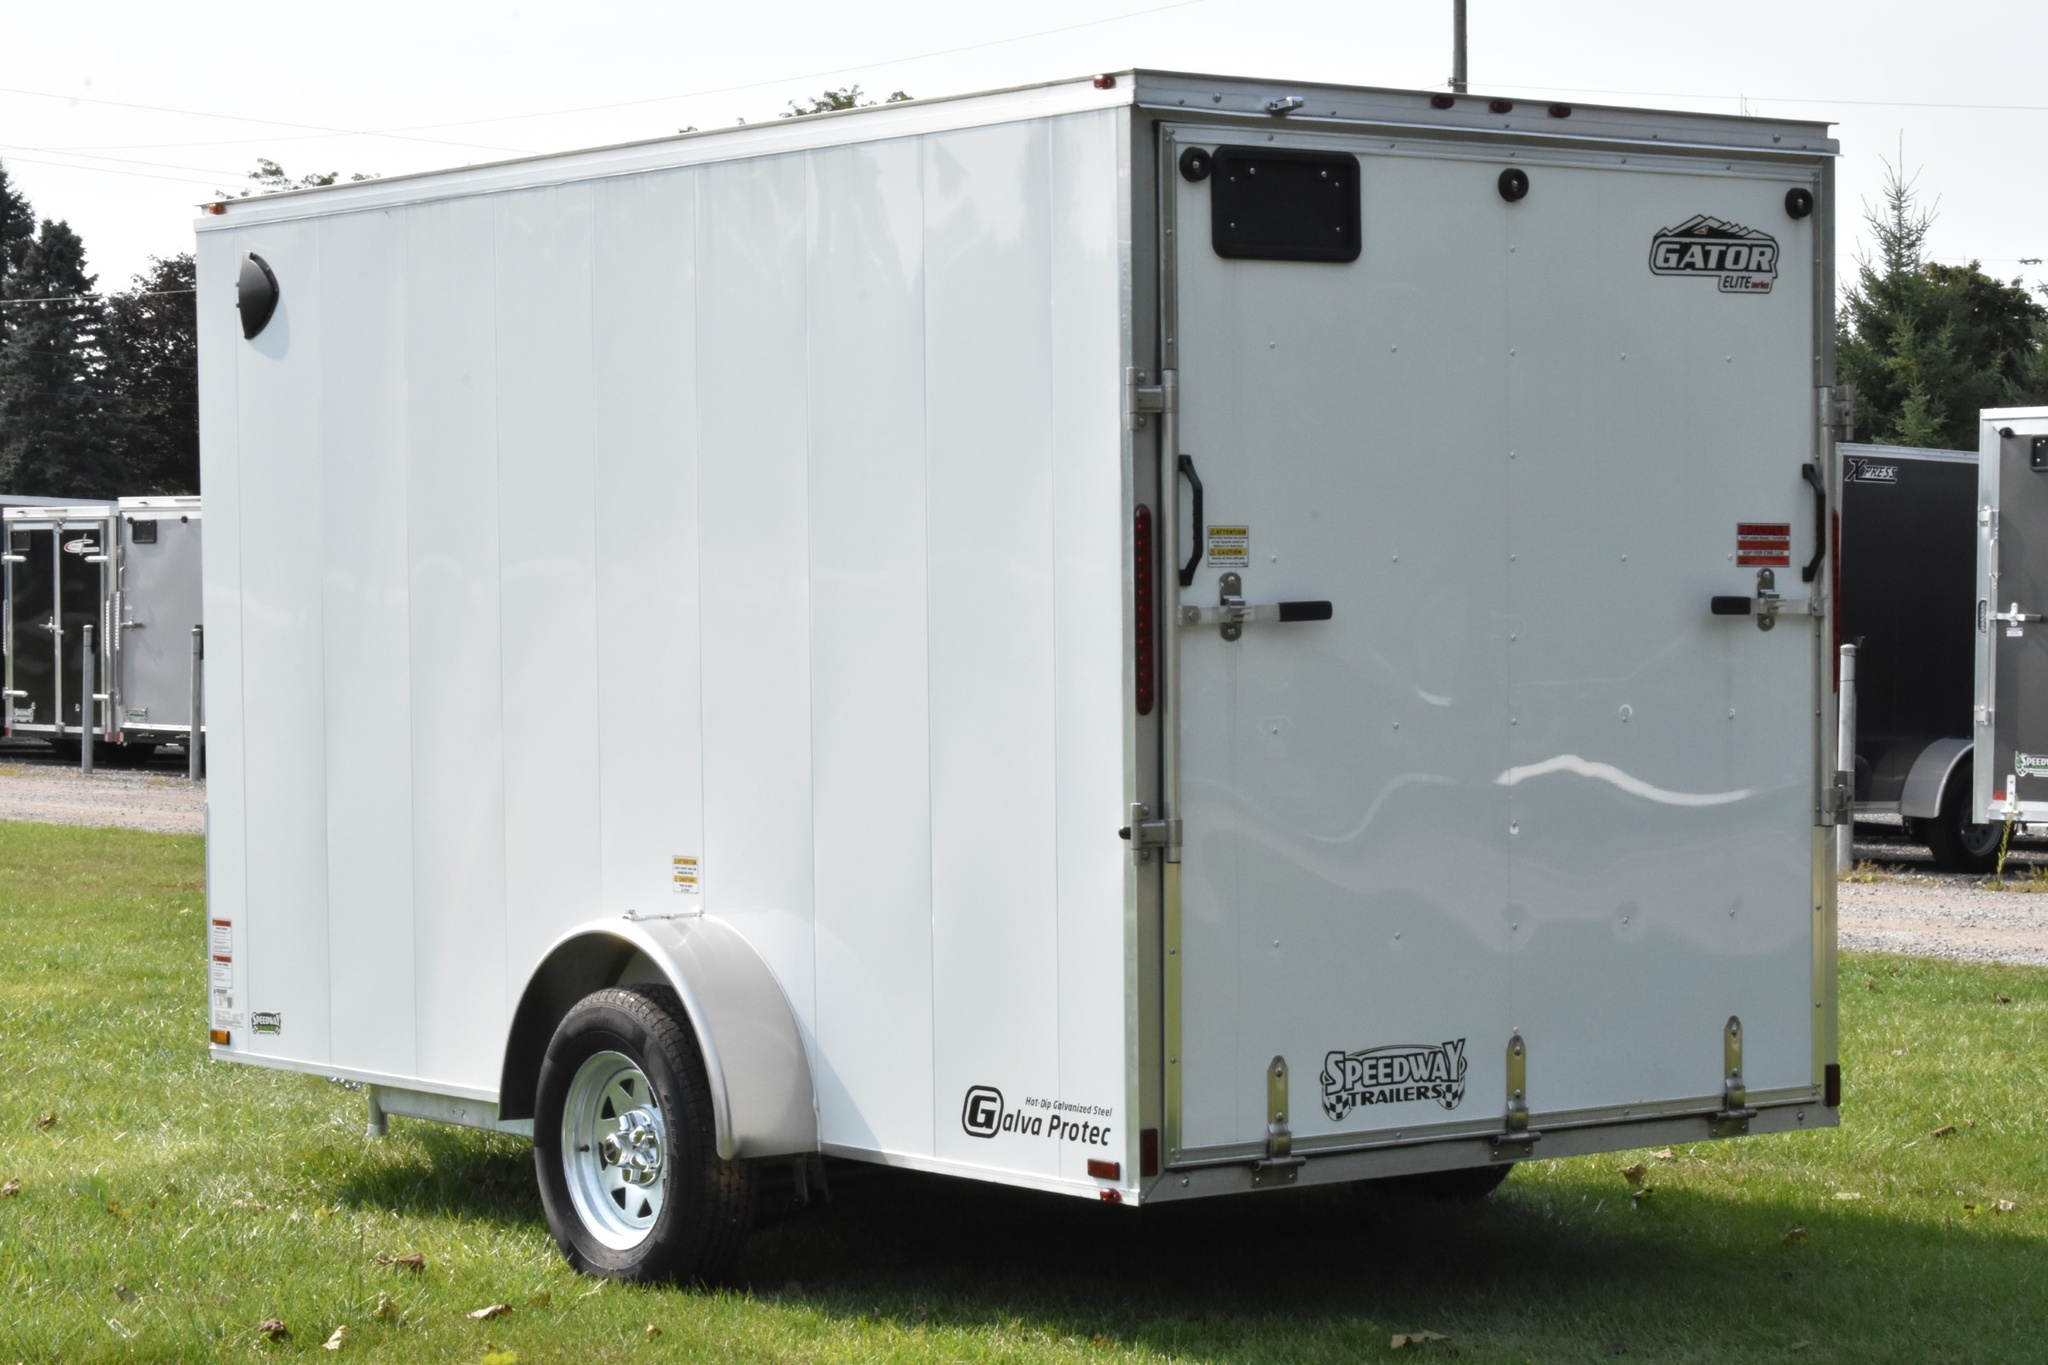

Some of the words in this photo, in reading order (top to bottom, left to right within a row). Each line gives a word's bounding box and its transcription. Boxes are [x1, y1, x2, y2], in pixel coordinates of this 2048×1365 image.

[1653, 240, 1775, 273] GATOR
[1722, 275, 1752, 289] ELITE
[1750, 281, 1770, 290] series
[1844, 458, 1898, 482] XPRESS
[2020, 753, 2048, 766] SPEED
[1325, 1038, 1466, 1096] SPEEDWAY
[1025, 1096, 1052, 1111] Hot-Dip
[1053, 1100, 1092, 1115] Galvanized
[1093, 1105, 1113, 1117] Steel
[1347, 1084, 1443, 1107] TRAILERS
[1048, 1114, 1111, 1147] Protec
